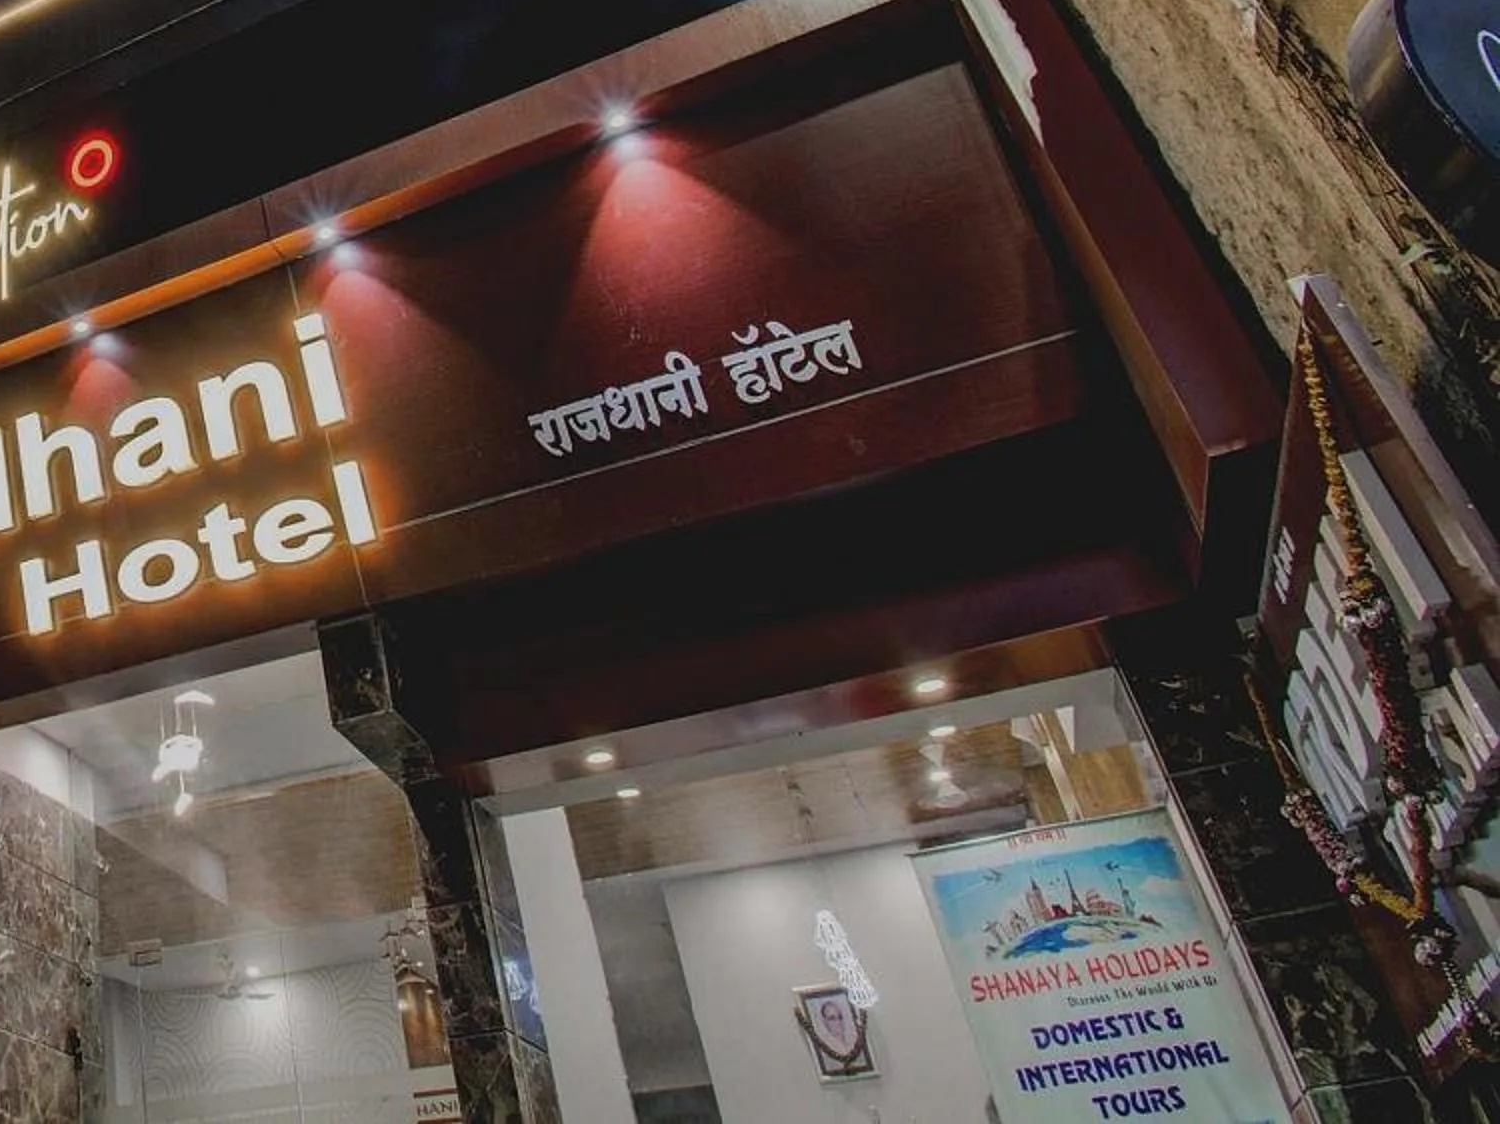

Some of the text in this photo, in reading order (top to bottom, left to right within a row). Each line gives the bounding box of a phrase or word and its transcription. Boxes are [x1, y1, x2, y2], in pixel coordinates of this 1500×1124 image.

[528, 319, 862, 457] राजधानी हॉटेल
[20, 460, 380, 635] Hotel
[969, 939, 1210, 1003] SHANAYA HOLIDAYS
[1031, 1006, 1185, 1050] DOMESTIC &
[1016, 1038, 1230, 1092] INTERNATIONAL
[1092, 1085, 1187, 1121] TOURS
